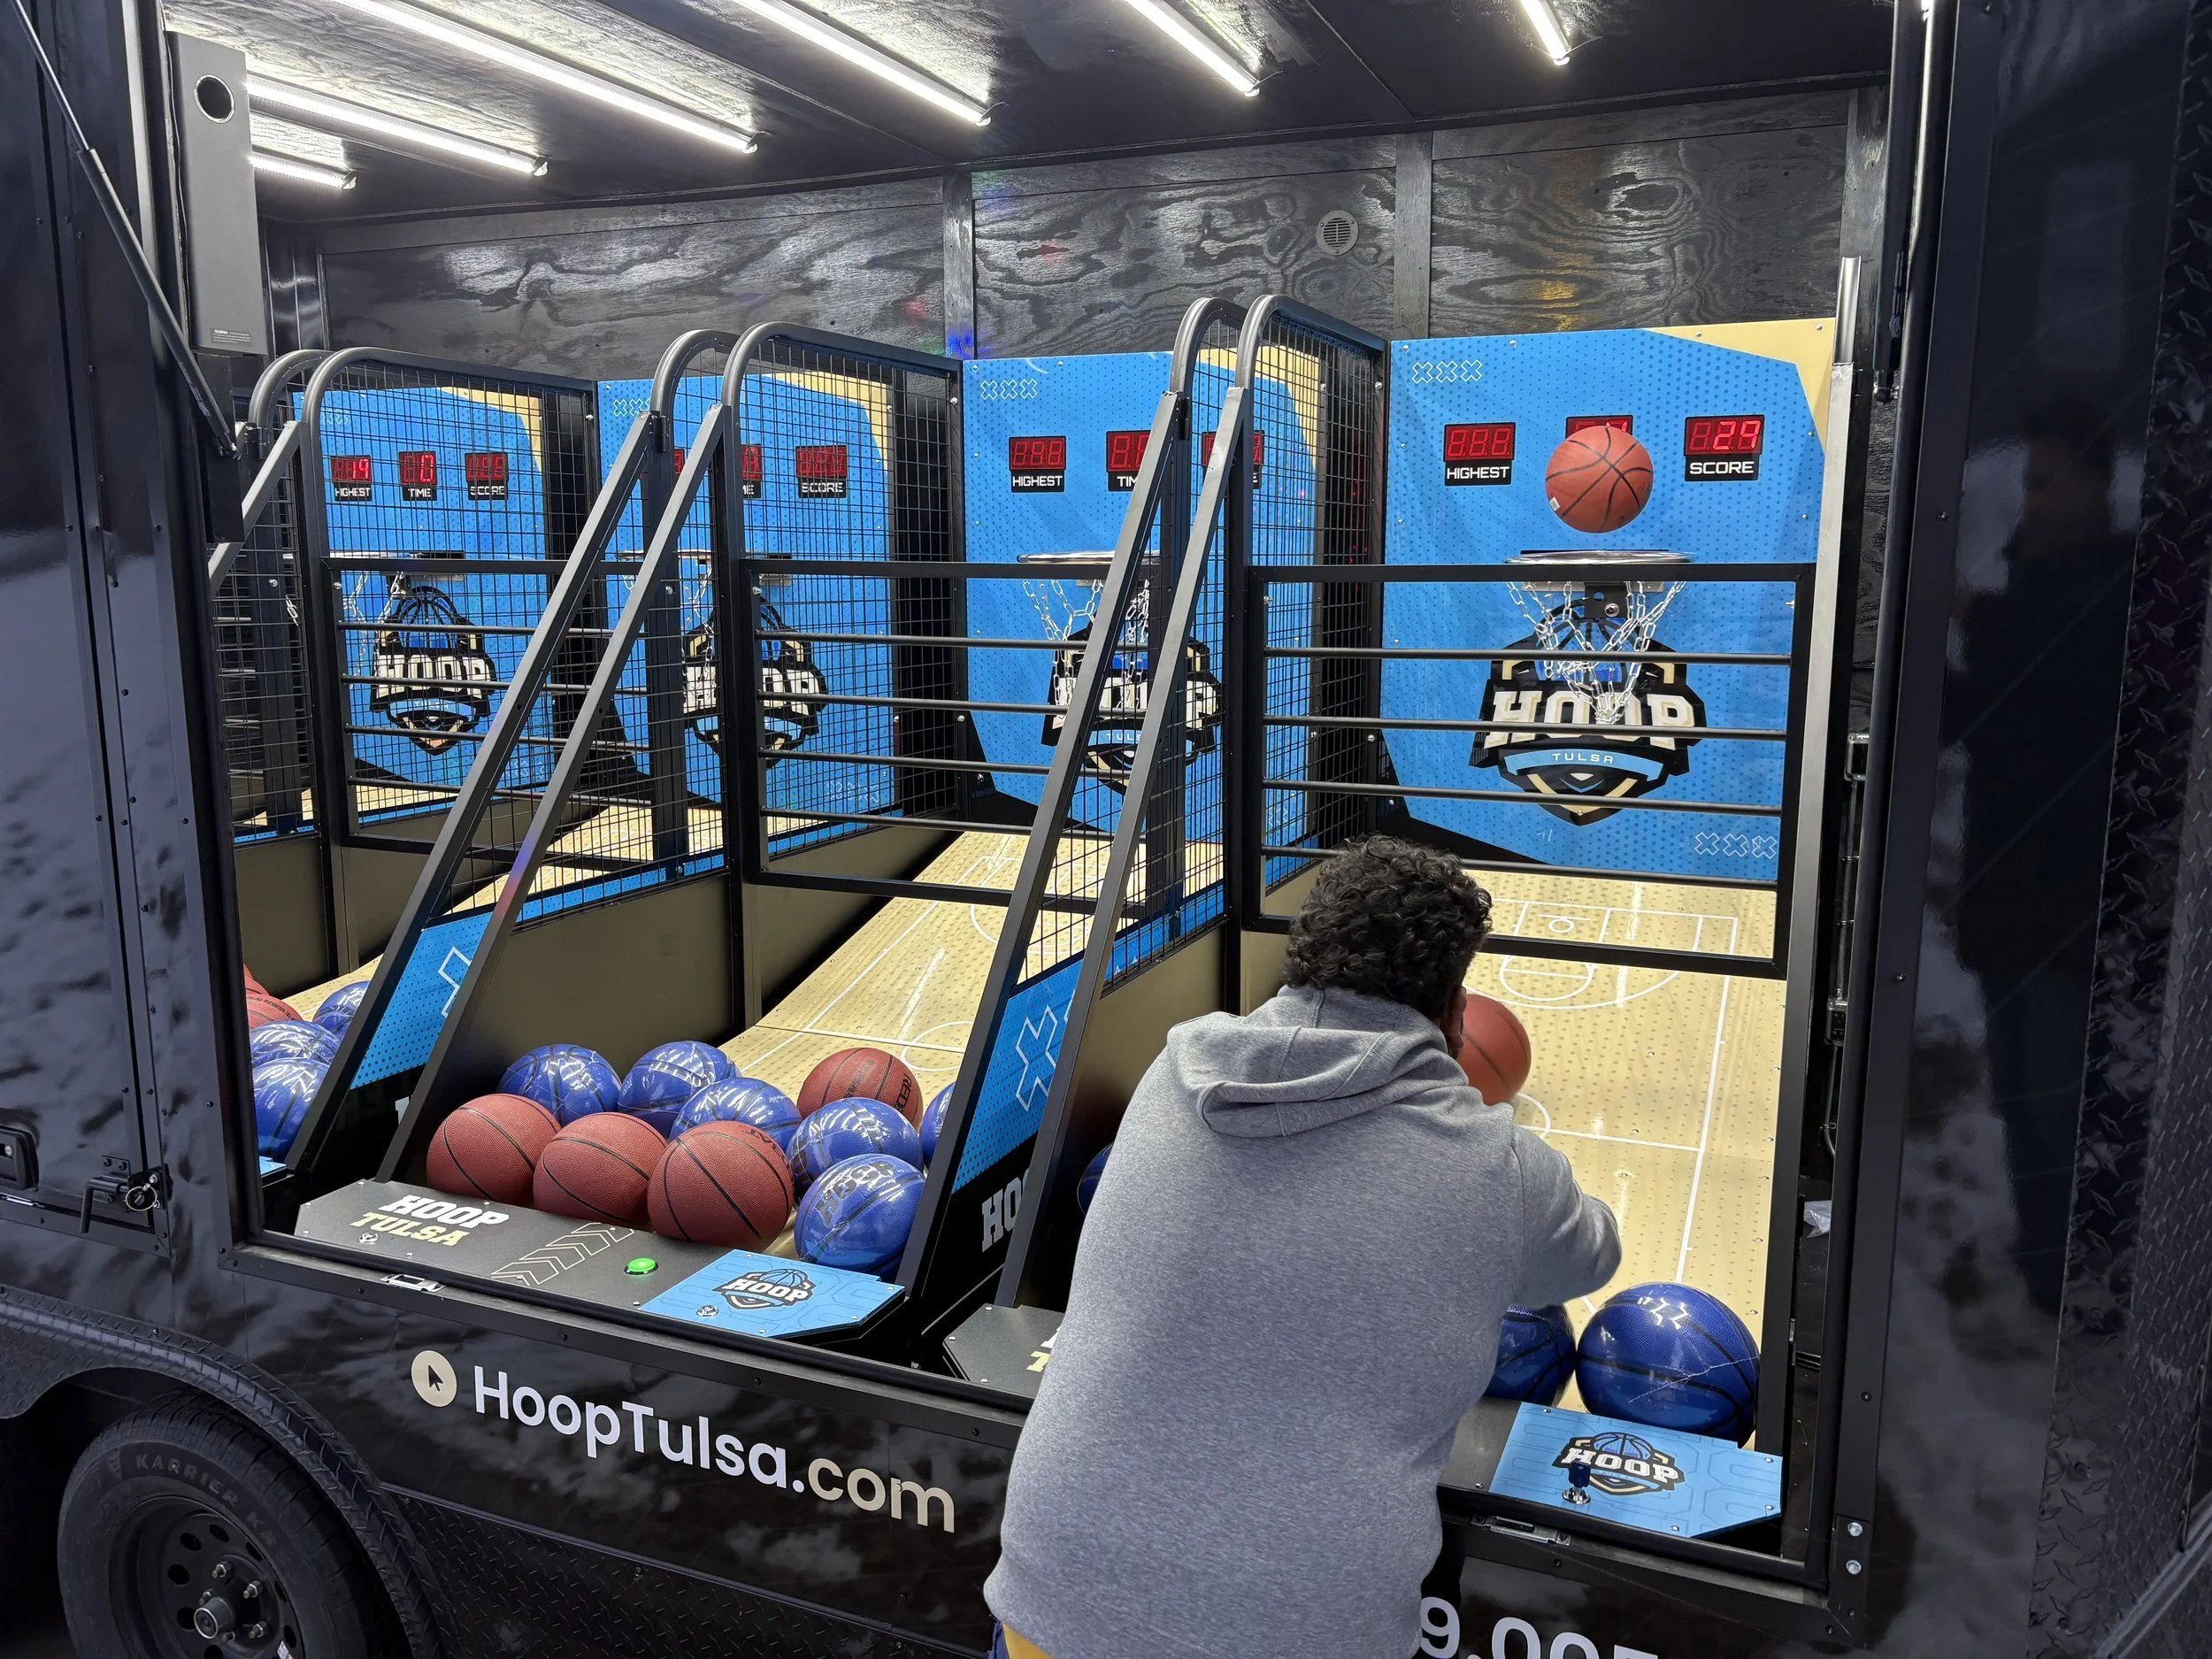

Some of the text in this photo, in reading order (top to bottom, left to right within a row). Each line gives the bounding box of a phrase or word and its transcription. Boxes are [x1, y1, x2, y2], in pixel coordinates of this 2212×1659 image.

[1447, 466, 1510, 480] HIGHEST
[1690, 461, 1755, 474] SCORE
[801, 482, 843, 493] SCORE
[1012, 475, 1063, 487] HIGHEST
[1117, 476, 1140, 487] TIM
[334, 488, 371, 496] HIGHEST
[407, 488, 432, 497] TIME
[470, 486, 505, 495] SCORE
[376, 654, 491, 699] HOOP
[683, 665, 819, 717] HOP
[1484, 690, 1695, 750] HOOP
[1106, 733, 1141, 741] TULS
[1552, 752, 1614, 764] TULSA
[379, 1194, 510, 1229] HOOP
[982, 1167, 1029, 1253] HO
[349, 1212, 470, 1247] TULSA
[721, 1279, 810, 1302] HOOP
[473, 1364, 956, 1534] HoopTulsa.com
[1560, 1448, 1679, 1484] HOOP
[135, 1453, 240, 1506] KARRIER
